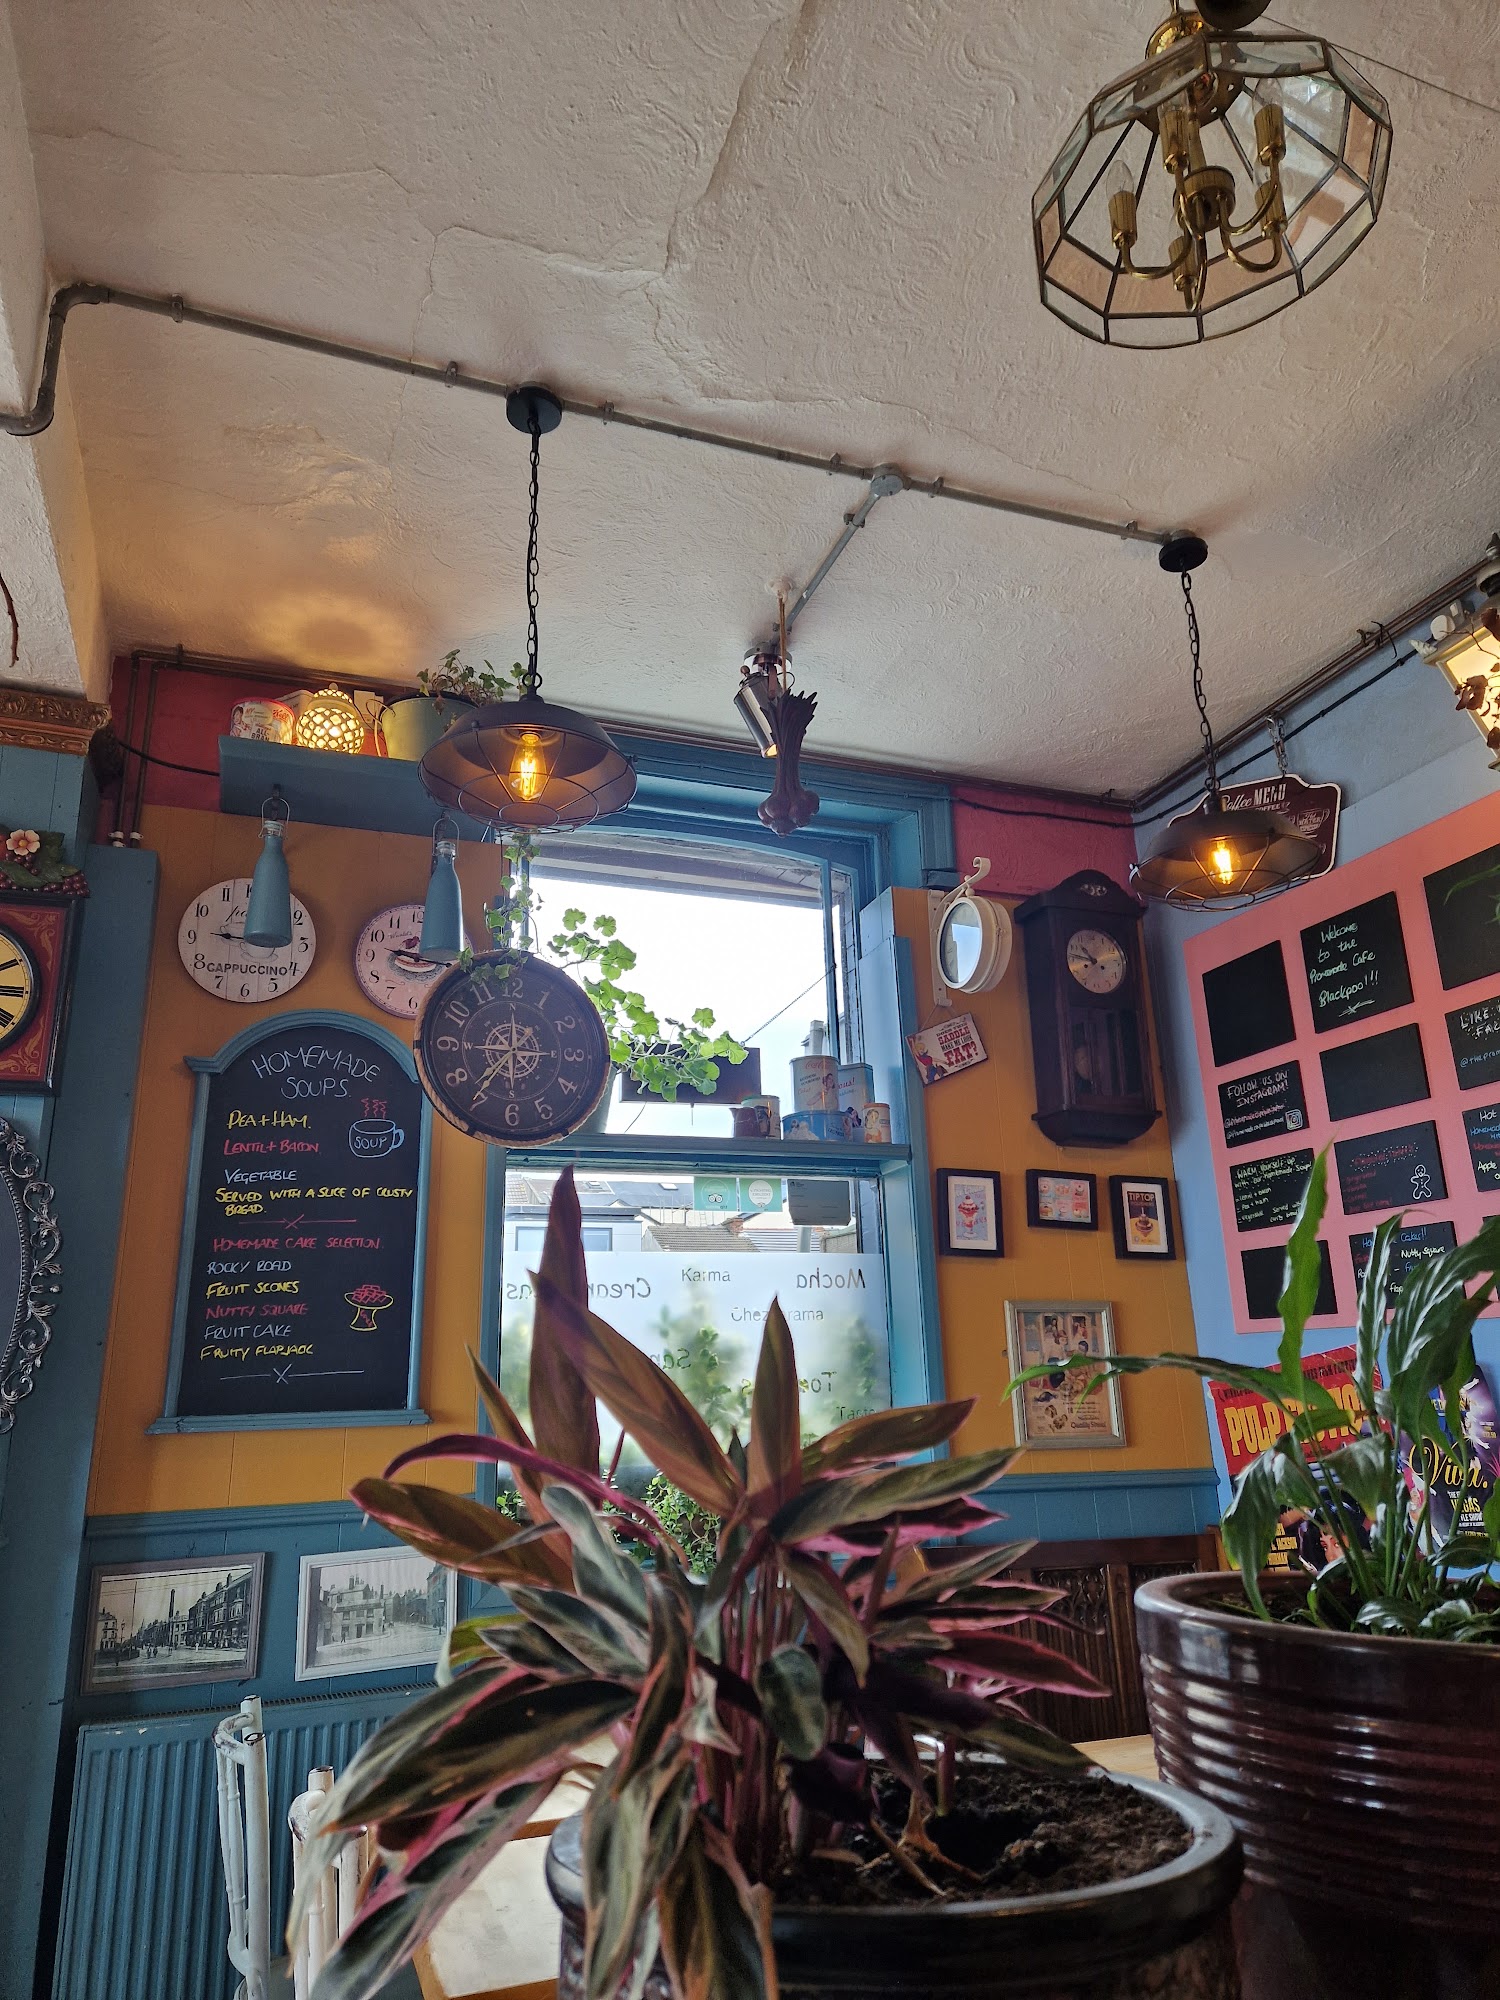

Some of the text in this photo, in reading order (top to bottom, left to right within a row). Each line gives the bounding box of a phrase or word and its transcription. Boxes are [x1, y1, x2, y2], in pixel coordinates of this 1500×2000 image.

[1253, 783, 1287, 806] MENU
[194, 904, 209, 918] 10
[293, 910, 304, 926] 2
[389, 914, 401, 929] 11
[187, 929, 197, 944] 9
[370, 929, 385, 943] 10
[299, 937, 309, 953] 3
[1318, 938, 1358, 963] to the
[194, 953, 206, 970] 8
[365, 949, 376, 963] 9
[206, 962, 288, 977] CAPPUCCINO
[288, 961, 300, 977] 4
[369, 970, 379, 984] 8
[213, 975, 224, 990] 7
[240, 983, 250, 998] 6
[268, 978, 278, 993] 5
[385, 986, 396, 999] 7
[469, 981, 495, 1006] 11
[533, 990, 550, 1010] 1
[408, 996, 418, 1010] 6
[509, 1003, 516, 1011] N
[444, 1000, 470, 1028] 10
[1460, 1008, 1489, 1029] LIKE
[554, 1015, 576, 1034] 2
[937, 1026, 971, 1045] SADDLE
[436, 1036, 460, 1052] 9
[463, 1041, 474, 1050] W
[940, 1041, 954, 1052] MAKE
[551, 1050, 558, 1058] E
[563, 1047, 585, 1062] 3
[943, 1040, 979, 1068] FAT?
[251, 1045, 381, 1082] HOMEMADE
[445, 1067, 468, 1088] 8
[1227, 1079, 1258, 1099] FOLLOW
[1275, 1070, 1289, 1081] ON
[557, 1076, 578, 1096] 4
[508, 1090, 515, 1099] S
[504, 1103, 520, 1127] 6
[534, 1096, 553, 1120] 5
[353, 1136, 387, 1150] SOUP
[1477, 1160, 1498, 1174] Apple
[224, 1168, 297, 1185] VEGETABLE
[215, 1187, 414, 1203] SERVED WITH A SLICE OF CRUSTY
[213, 1237, 279, 1252] HOMEMADE
[285, 1237, 317, 1248] CAKE
[1401, 1248, 1422, 1260] Nutty
[206, 1260, 292, 1275] ROCKY ROAD
[681, 1268, 731, 1282] Karma
[205, 1280, 300, 1299] FRUIT SCONES
[205, 1303, 309, 1320] NUTTY SQUARE
[731, 1307, 768, 1322] Chez
[204, 1323, 292, 1340] FRUIT CAKE
[200, 1344, 314, 1361] FRUITY FLAPJACK
[1223, 1401, 1281, 1456] PULP
[1450, 1497, 1481, 1513] VGAS
